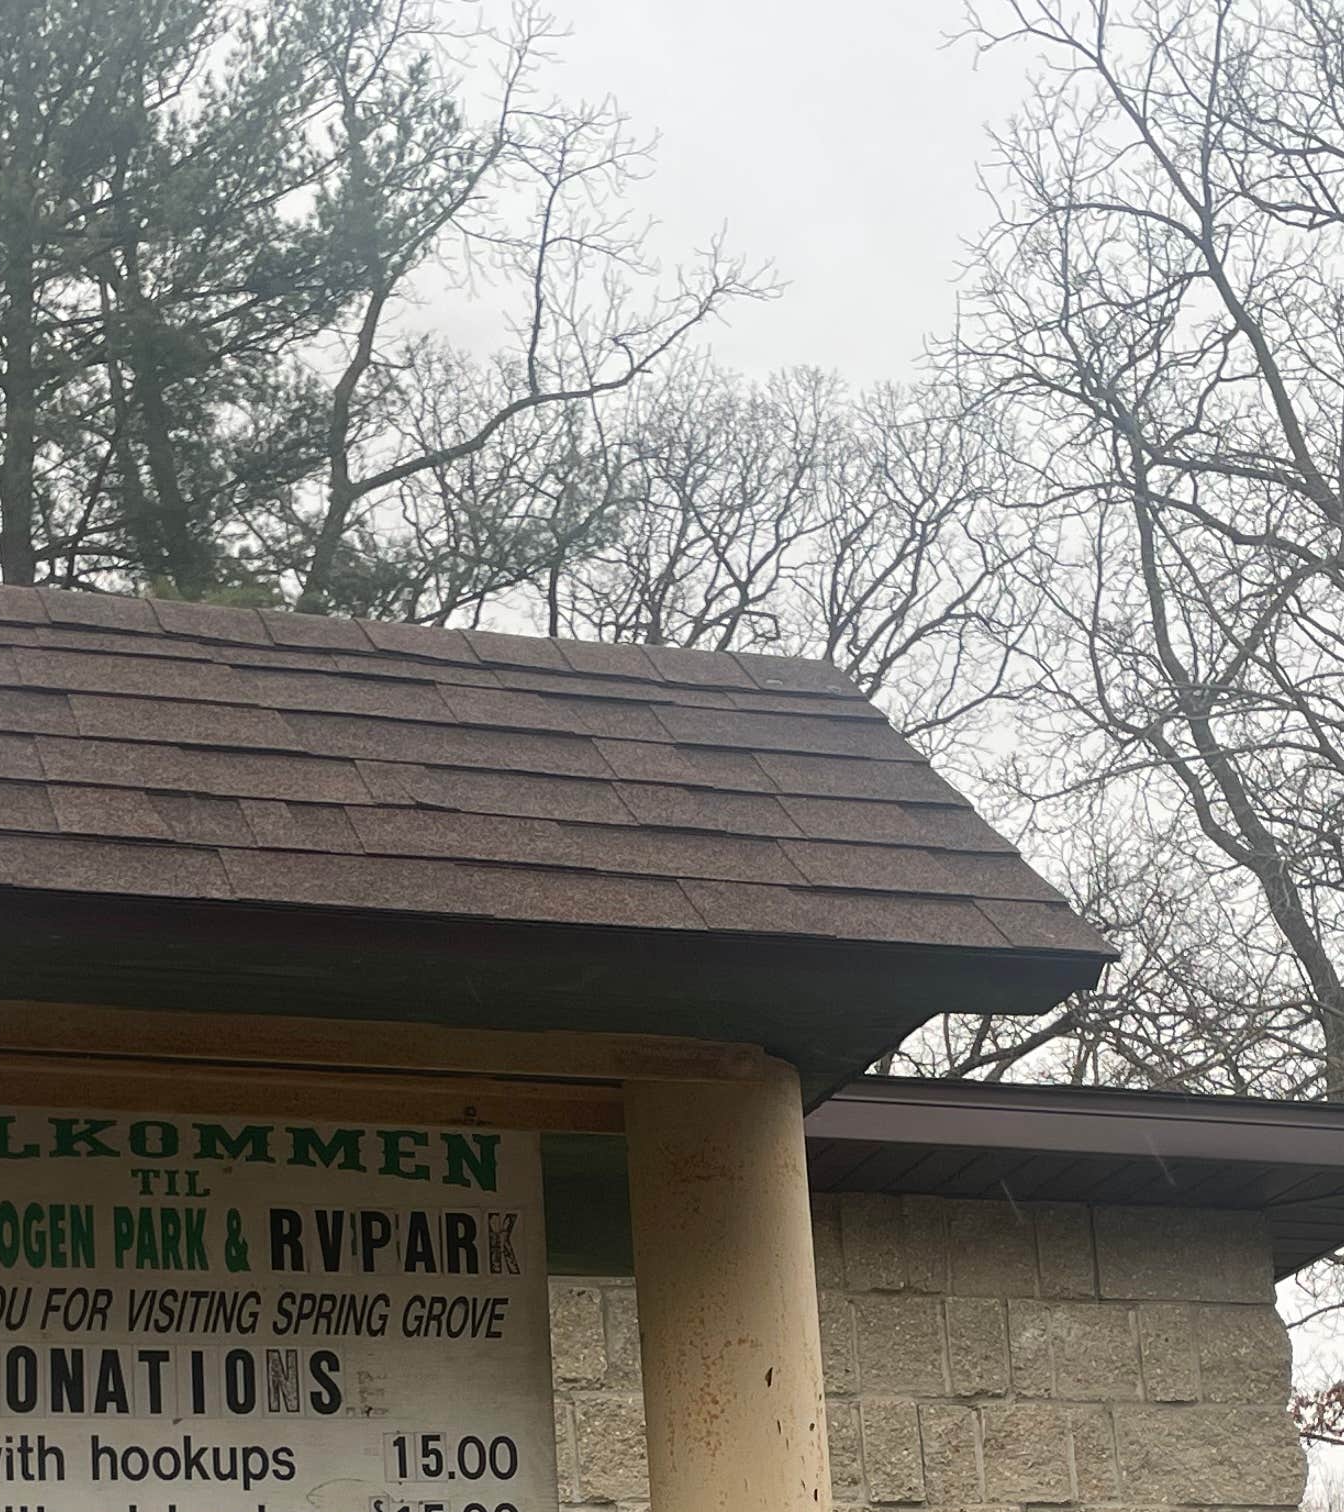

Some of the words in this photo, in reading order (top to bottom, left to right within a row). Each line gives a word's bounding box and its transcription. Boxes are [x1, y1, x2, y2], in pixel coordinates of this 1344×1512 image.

[131, 1168, 211, 1198] TIL
[114, 1206, 209, 1271] PARK
[225, 1208, 251, 1273] &
[40, 1287, 113, 1331] FOR
[127, 1288, 262, 1335] VISITING
[272, 1292, 391, 1338] SPRING
[402, 1295, 509, 1339] GROVE
[91, 1435, 296, 1491] hookups
[393, 1434, 518, 1480] 15.00
